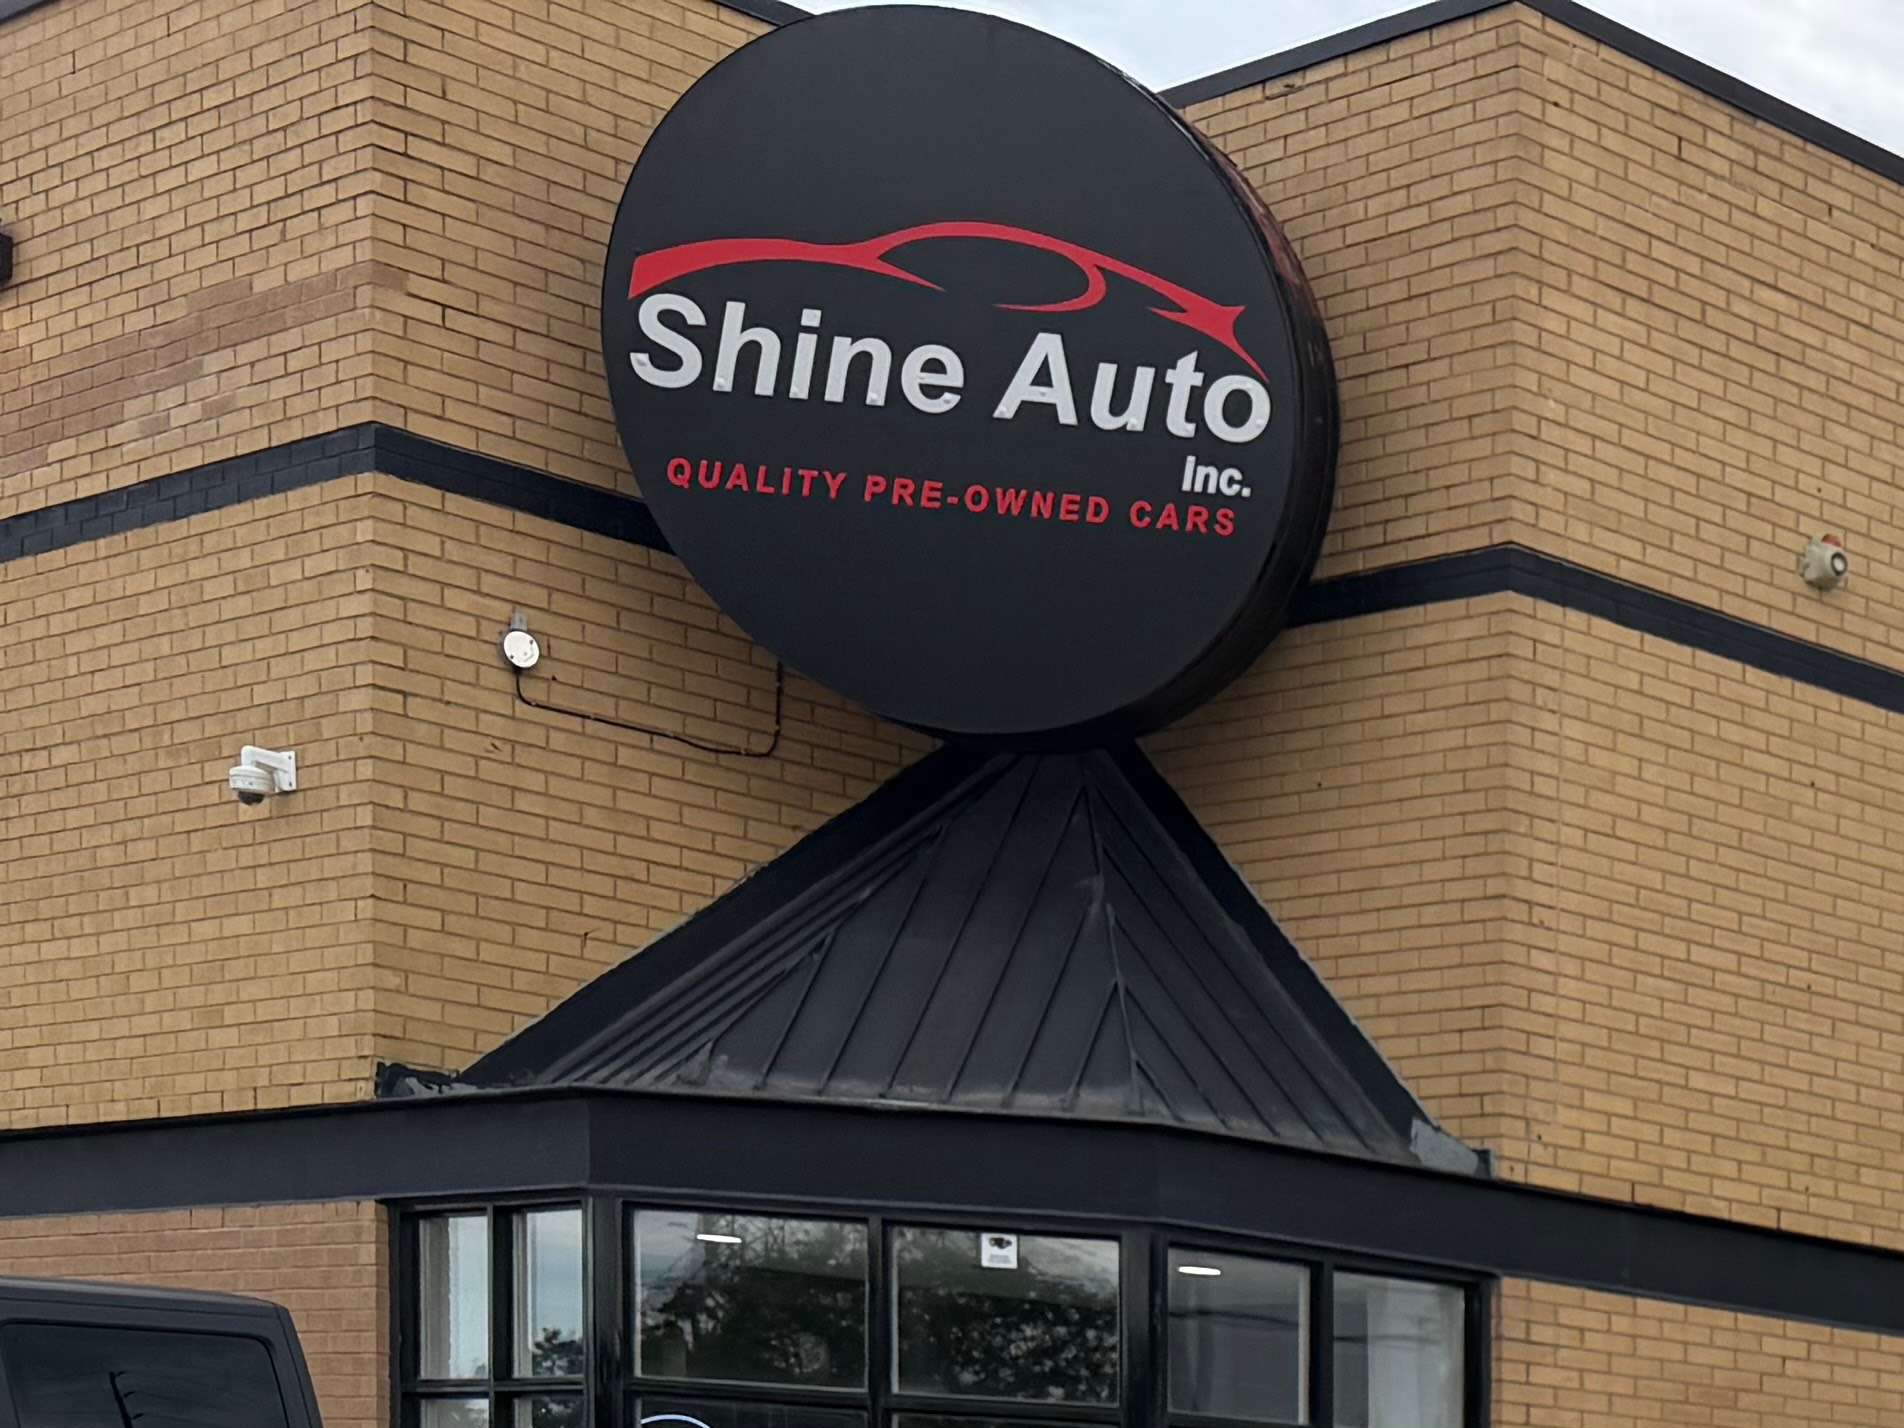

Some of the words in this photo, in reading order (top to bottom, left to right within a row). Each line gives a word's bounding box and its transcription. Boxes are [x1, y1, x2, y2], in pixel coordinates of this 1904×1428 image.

[629, 293, 965, 414] Shine
[992, 332, 1271, 443] Auto
[666, 457, 847, 499] QUALITY
[863, 475, 1109, 525] PRE-OWNED
[1129, 500, 1236, 537] CARS
[1181, 455, 1251, 497] Inc.
